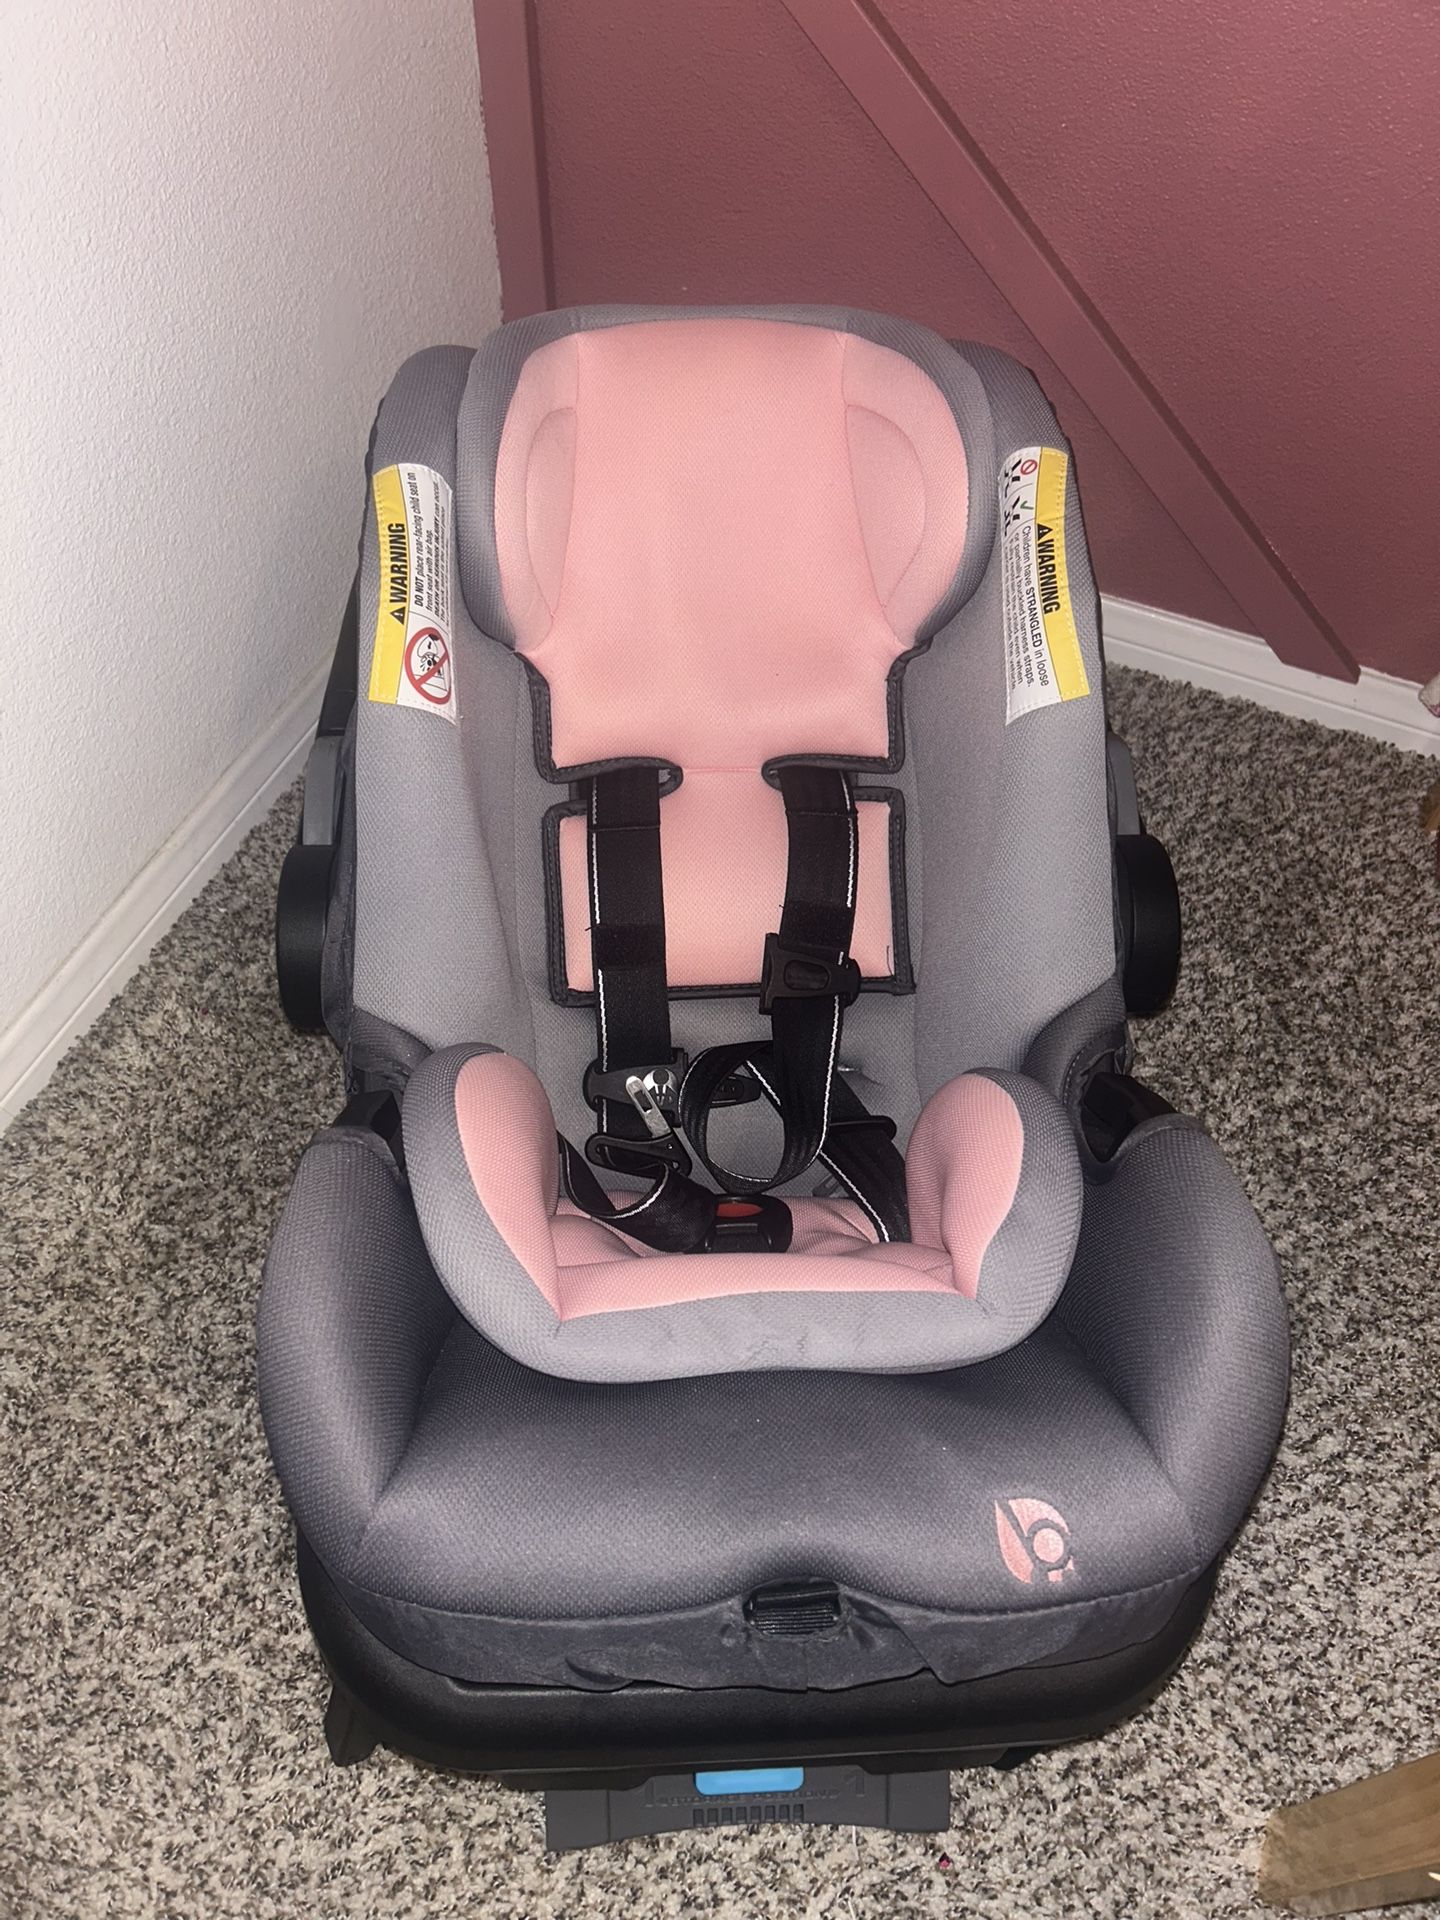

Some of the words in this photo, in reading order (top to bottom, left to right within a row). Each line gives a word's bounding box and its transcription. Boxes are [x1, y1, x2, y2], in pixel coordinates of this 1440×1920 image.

[407, 472, 417, 482] on
[408, 482, 419, 496] seat
[409, 496, 421, 514] child
[413, 515, 424, 556] rear-facing
[426, 529, 434, 545] bag.
[1022, 525, 1032, 563] Children
[425, 545, 433, 557] air
[1015, 544, 1023, 579] partially
[388, 523, 408, 604] WARNING
[416, 556, 426, 577] place
[1024, 563, 1033, 587] have
[414, 576, 424, 594] NOT
[1037, 539, 1061, 615] WARNING
[414, 595, 424, 607] DO
[425, 592, 433, 611] front
[1017, 578, 1027, 616] buckled
[1025, 587, 1043, 648] STRANGLED
[1019, 616, 1029, 654] harness
[1034, 648, 1045, 658] in
[1023, 655, 1035, 688] straps.
[1037, 659, 1050, 687] loose
